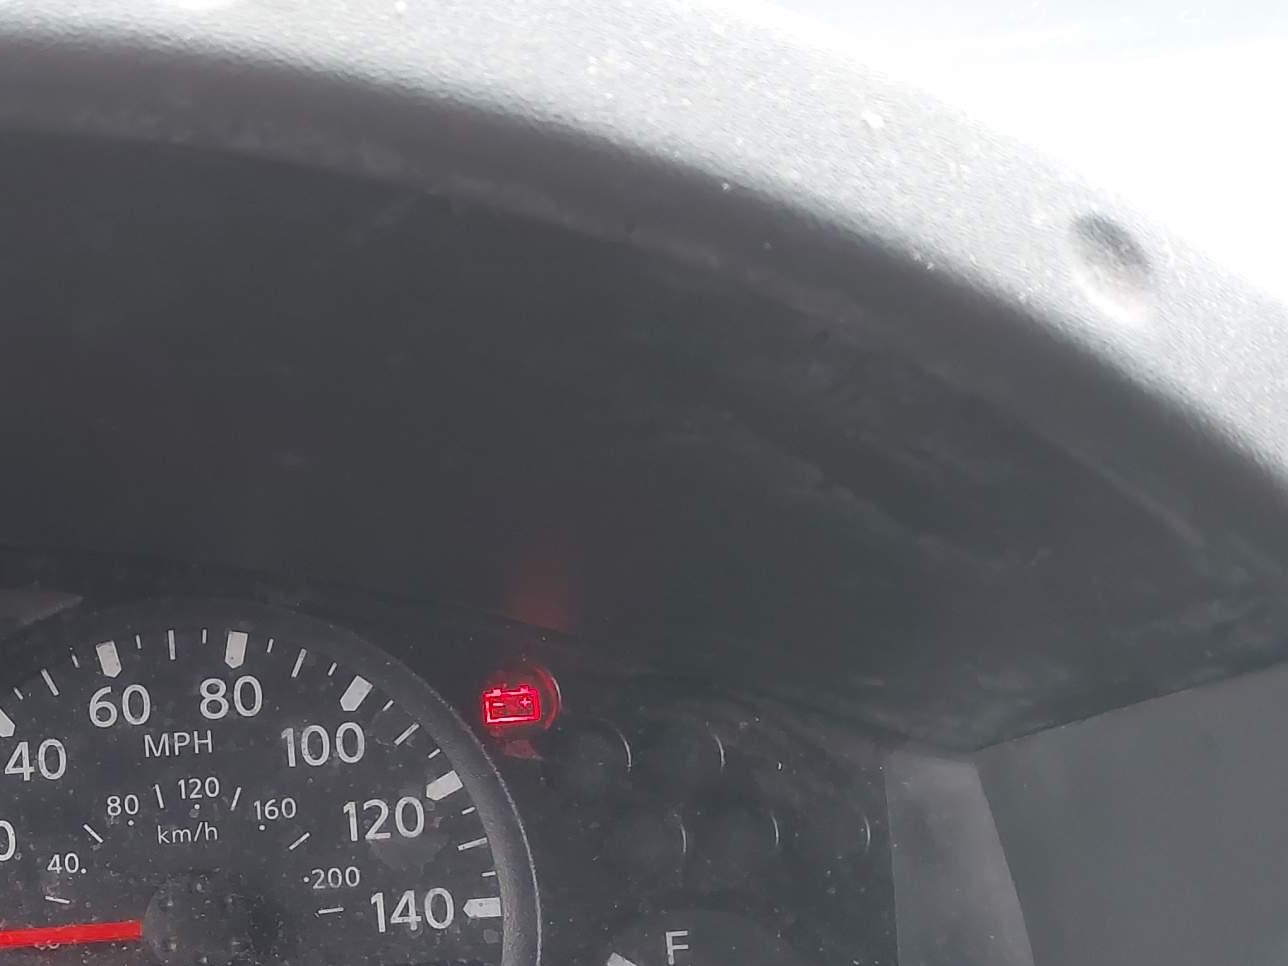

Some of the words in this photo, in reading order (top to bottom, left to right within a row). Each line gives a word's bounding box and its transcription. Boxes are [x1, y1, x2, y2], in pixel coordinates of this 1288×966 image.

[88, 684, 151, 728] 60
[199, 675, 263, 720] 80
[4, 738, 67, 781] 40
[144, 731, 212, 758] MPH
[281, 722, 365, 767] 100
[177, 776, 220, 800] 120
[106, 794, 140, 817] 80
[253, 797, 297, 821] 160
[343, 796, 425, 842] 120
[157, 822, 219, 845] km/h
[47, 852, 80, 875] 40
[311, 866, 361, 890] 200
[370, 887, 455, 933] 140
[665, 930, 690, 966] F
